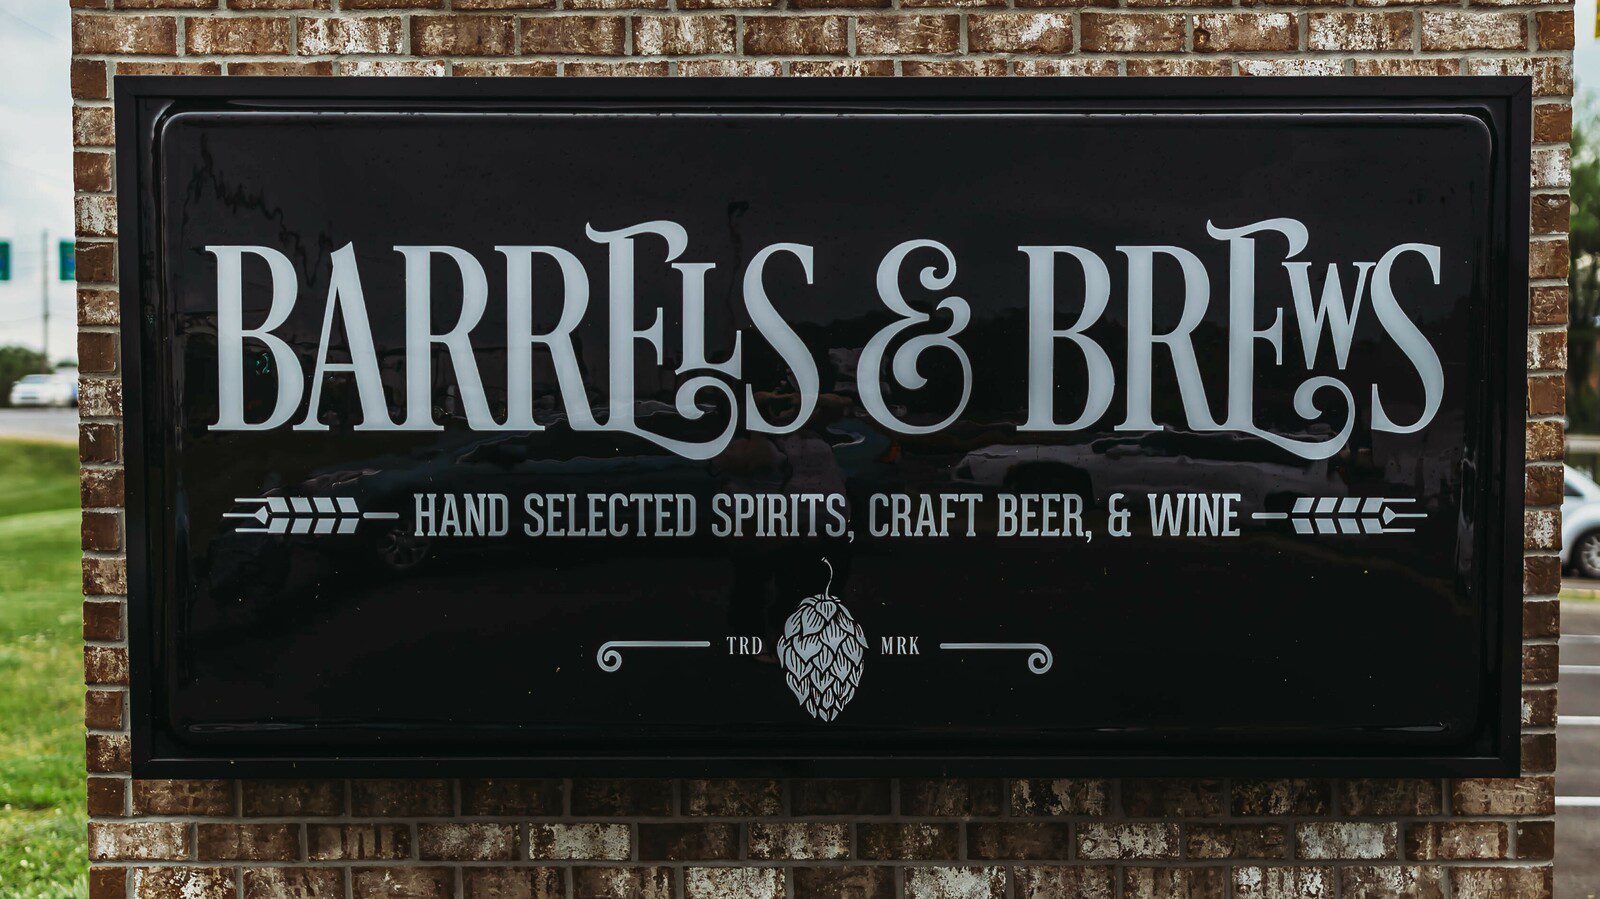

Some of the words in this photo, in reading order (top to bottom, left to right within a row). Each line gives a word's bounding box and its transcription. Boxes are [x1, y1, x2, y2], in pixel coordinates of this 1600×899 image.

[205, 220, 820, 460] BARRELS
[856, 239, 972, 435] &
[1016, 217, 1445, 460] BREWS
[413, 493, 509, 537] HAND
[523, 493, 697, 537] SELECTED
[711, 493, 855, 543] SPIRITS,
[869, 493, 983, 537] CRAFT
[996, 493, 1092, 544] BEER,
[1107, 492, 1132, 537] &
[1147, 493, 1242, 537] WINE
[726, 636, 763, 655] TRD
[880, 636, 920, 655] MRK
